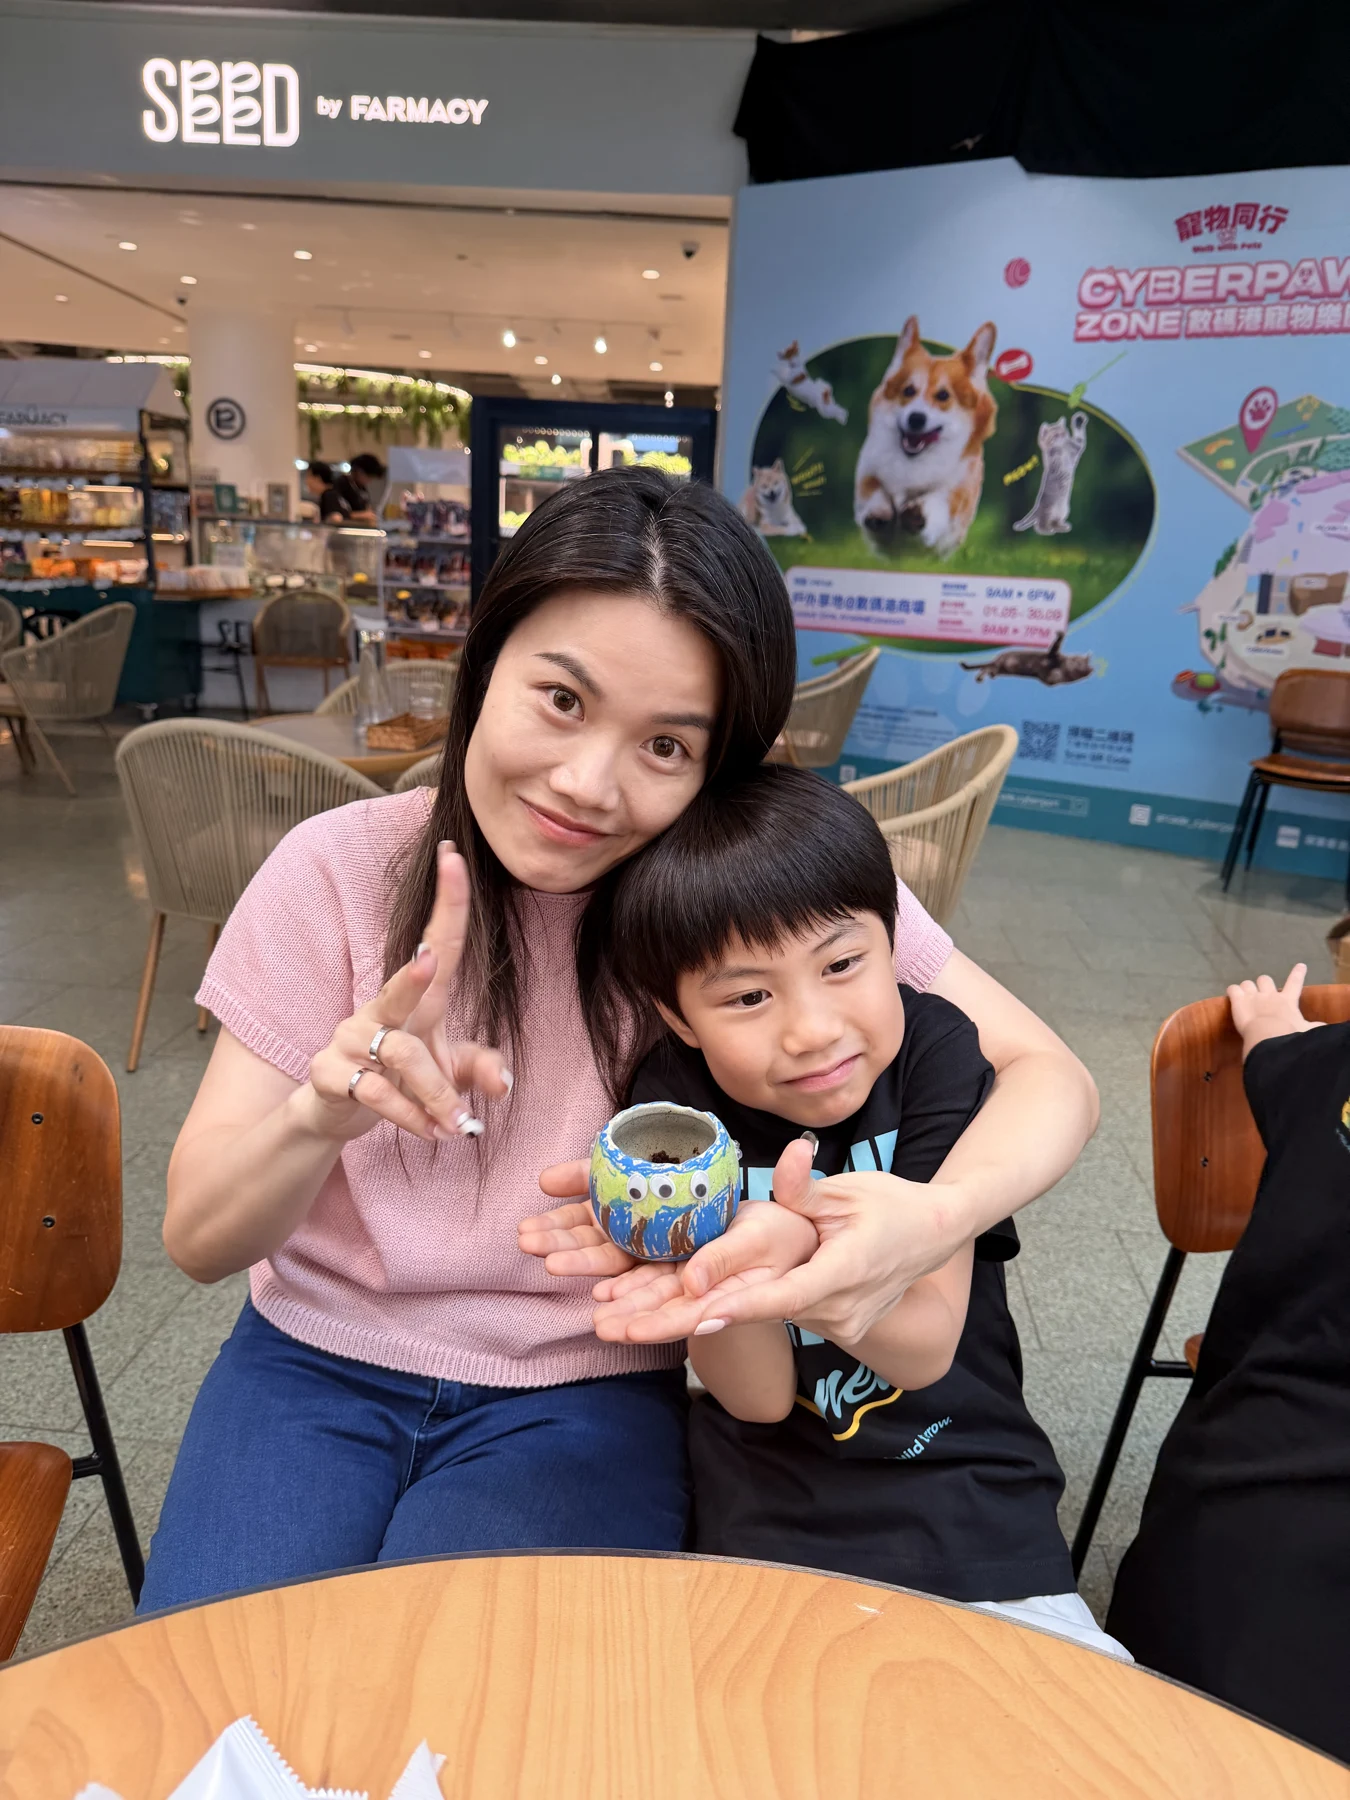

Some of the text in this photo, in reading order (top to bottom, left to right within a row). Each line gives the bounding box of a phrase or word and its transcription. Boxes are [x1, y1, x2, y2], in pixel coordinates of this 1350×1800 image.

[142, 57, 488, 147] SEED by FARMACY
[1174, 202, 1289, 243] 寵物同行
[1074, 302, 1350, 342] ZONE 數碼港寵物樂
